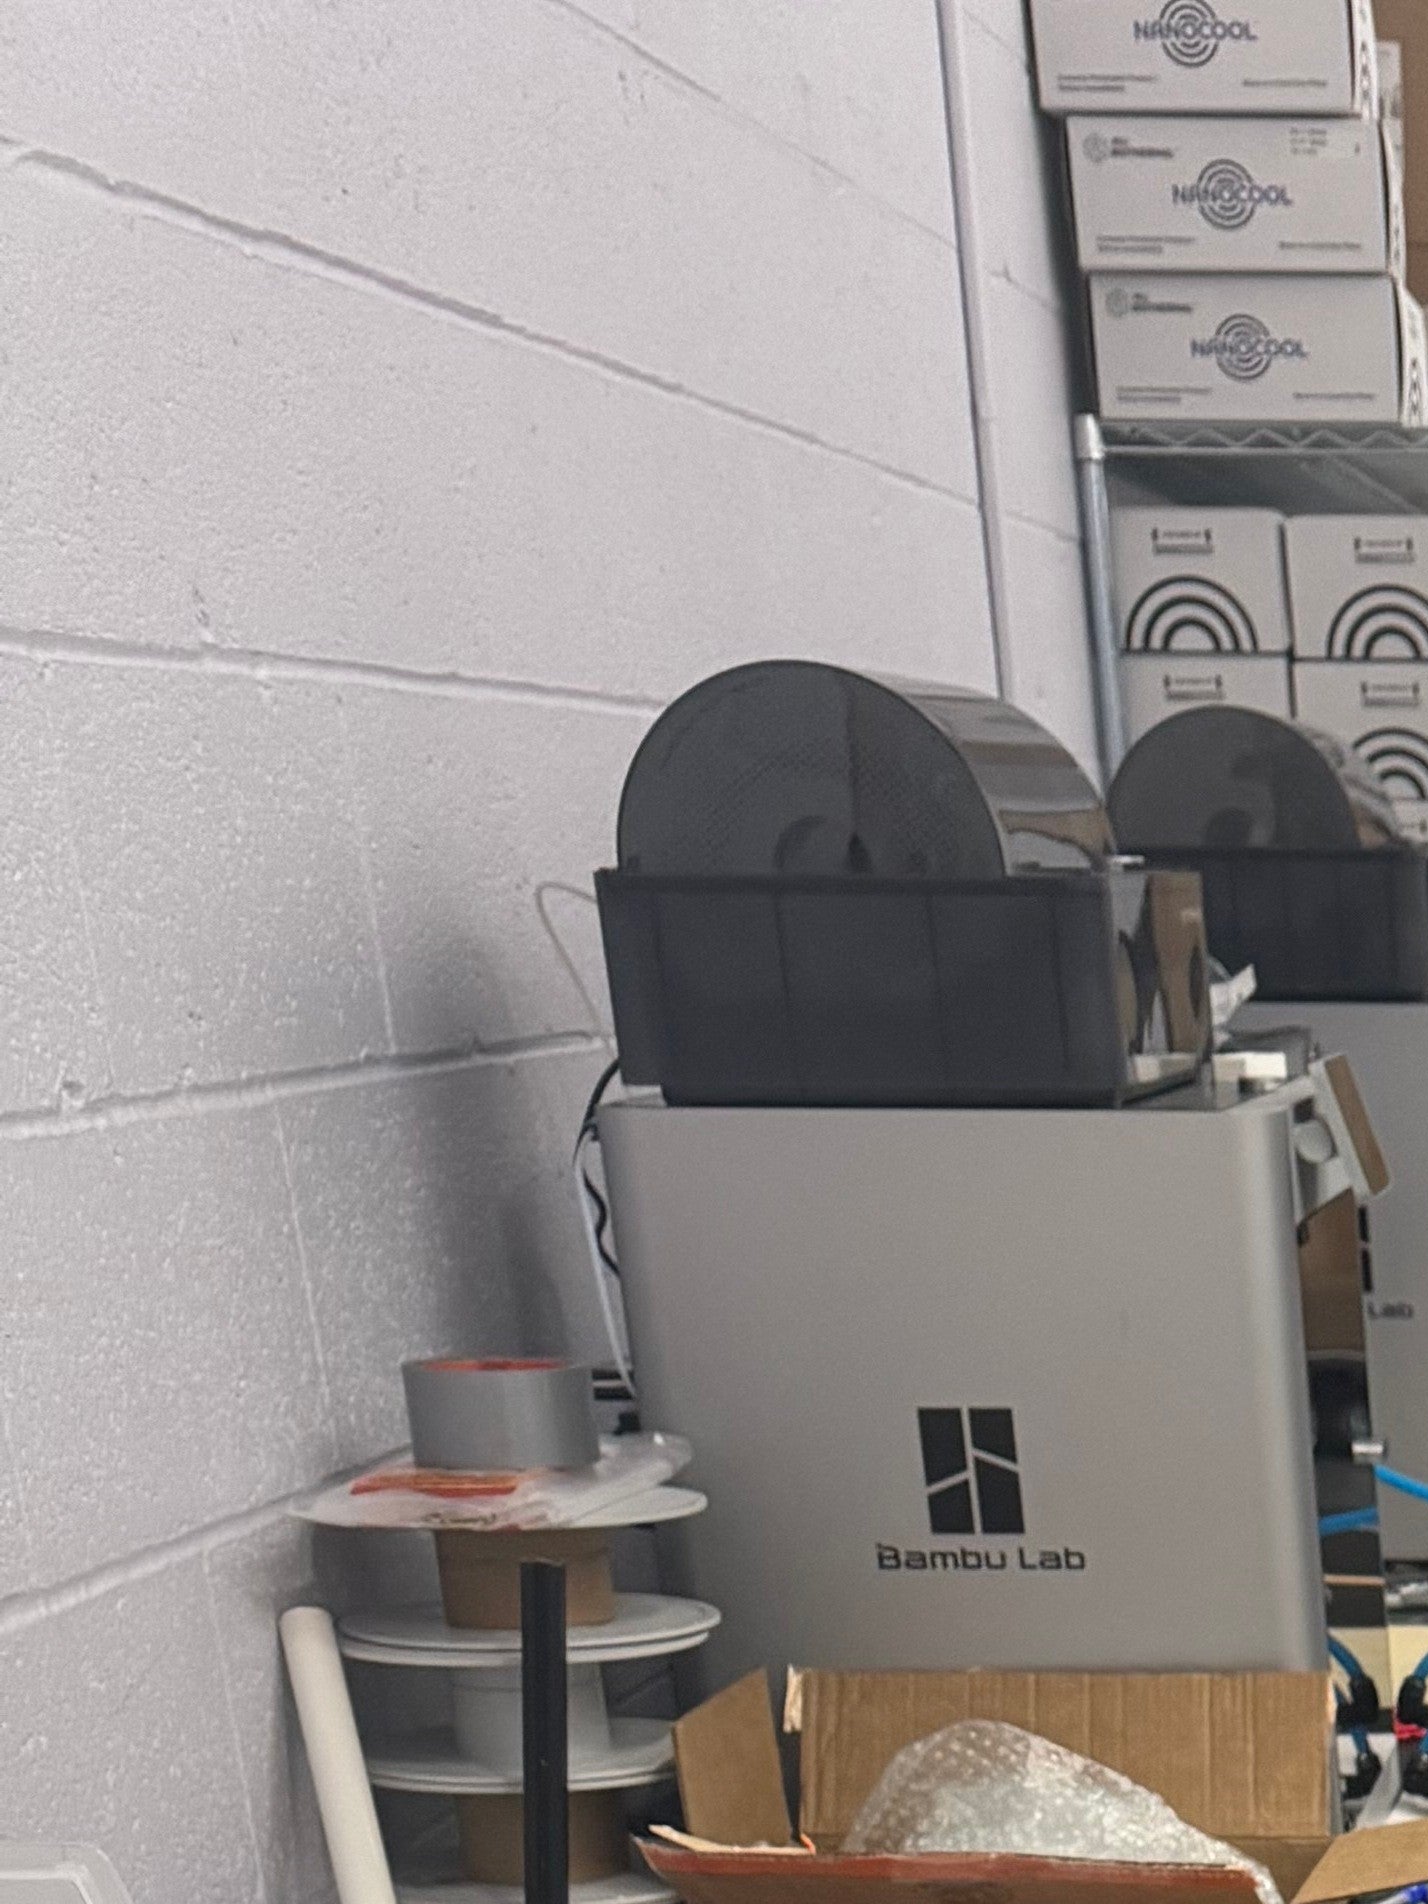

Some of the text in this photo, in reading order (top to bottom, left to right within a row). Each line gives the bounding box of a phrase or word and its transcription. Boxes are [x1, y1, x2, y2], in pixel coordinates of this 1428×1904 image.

[1135, 20, 1257, 42] NANOCOOL
[1173, 183, 1292, 206] NANOCOOL
[1191, 338, 1307, 359] NANOCOOL
[876, 1543, 1086, 1570] Bambu Lab
